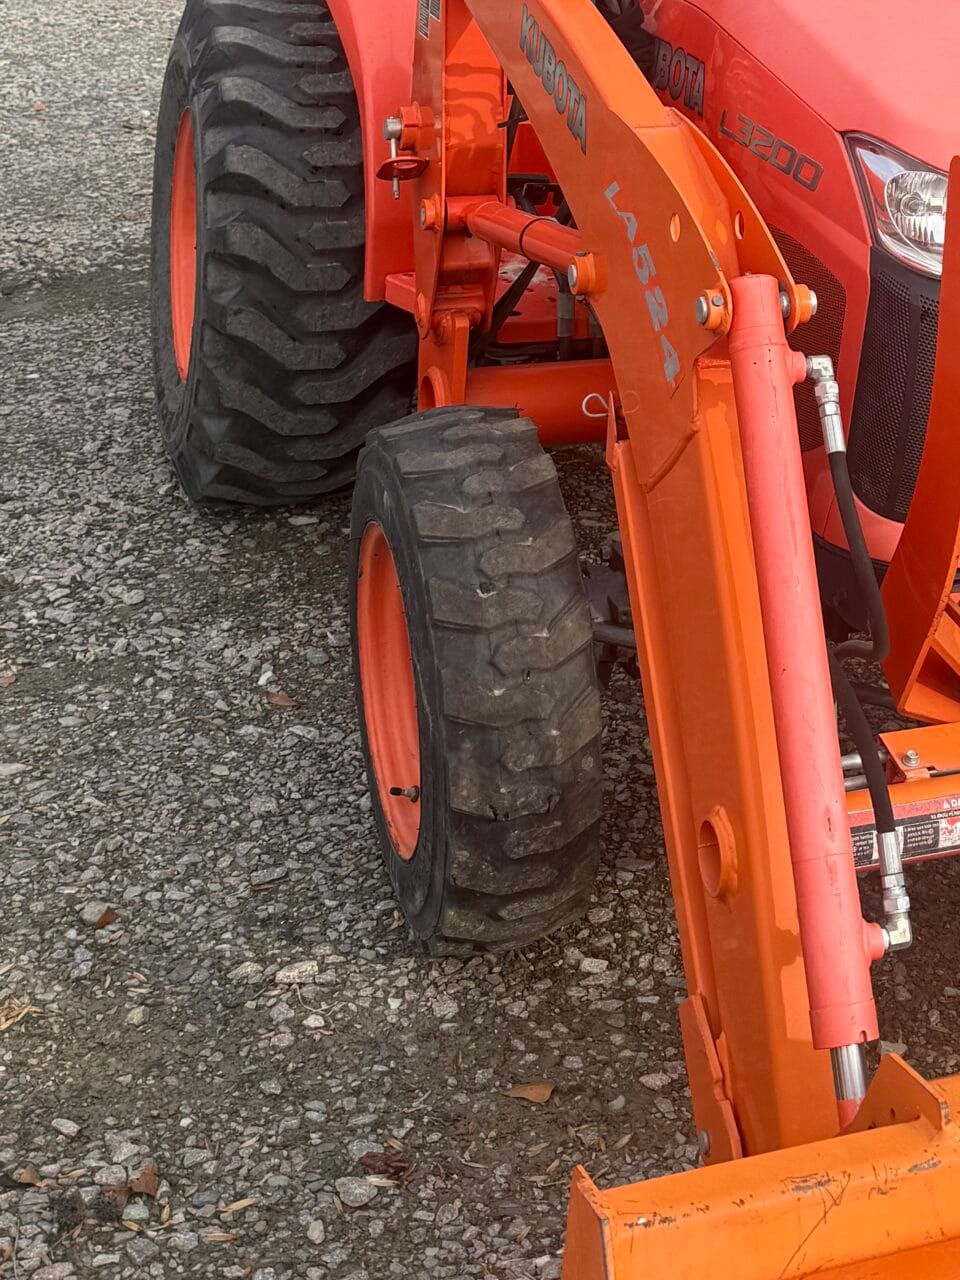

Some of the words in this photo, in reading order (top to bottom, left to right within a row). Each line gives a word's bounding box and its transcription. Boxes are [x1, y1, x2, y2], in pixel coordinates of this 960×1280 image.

[519, 2, 587, 156] KUBOTA
[655, 37, 706, 118] BOTA
[719, 109, 825, 192] L3200
[604, 181, 681, 388] LA524
